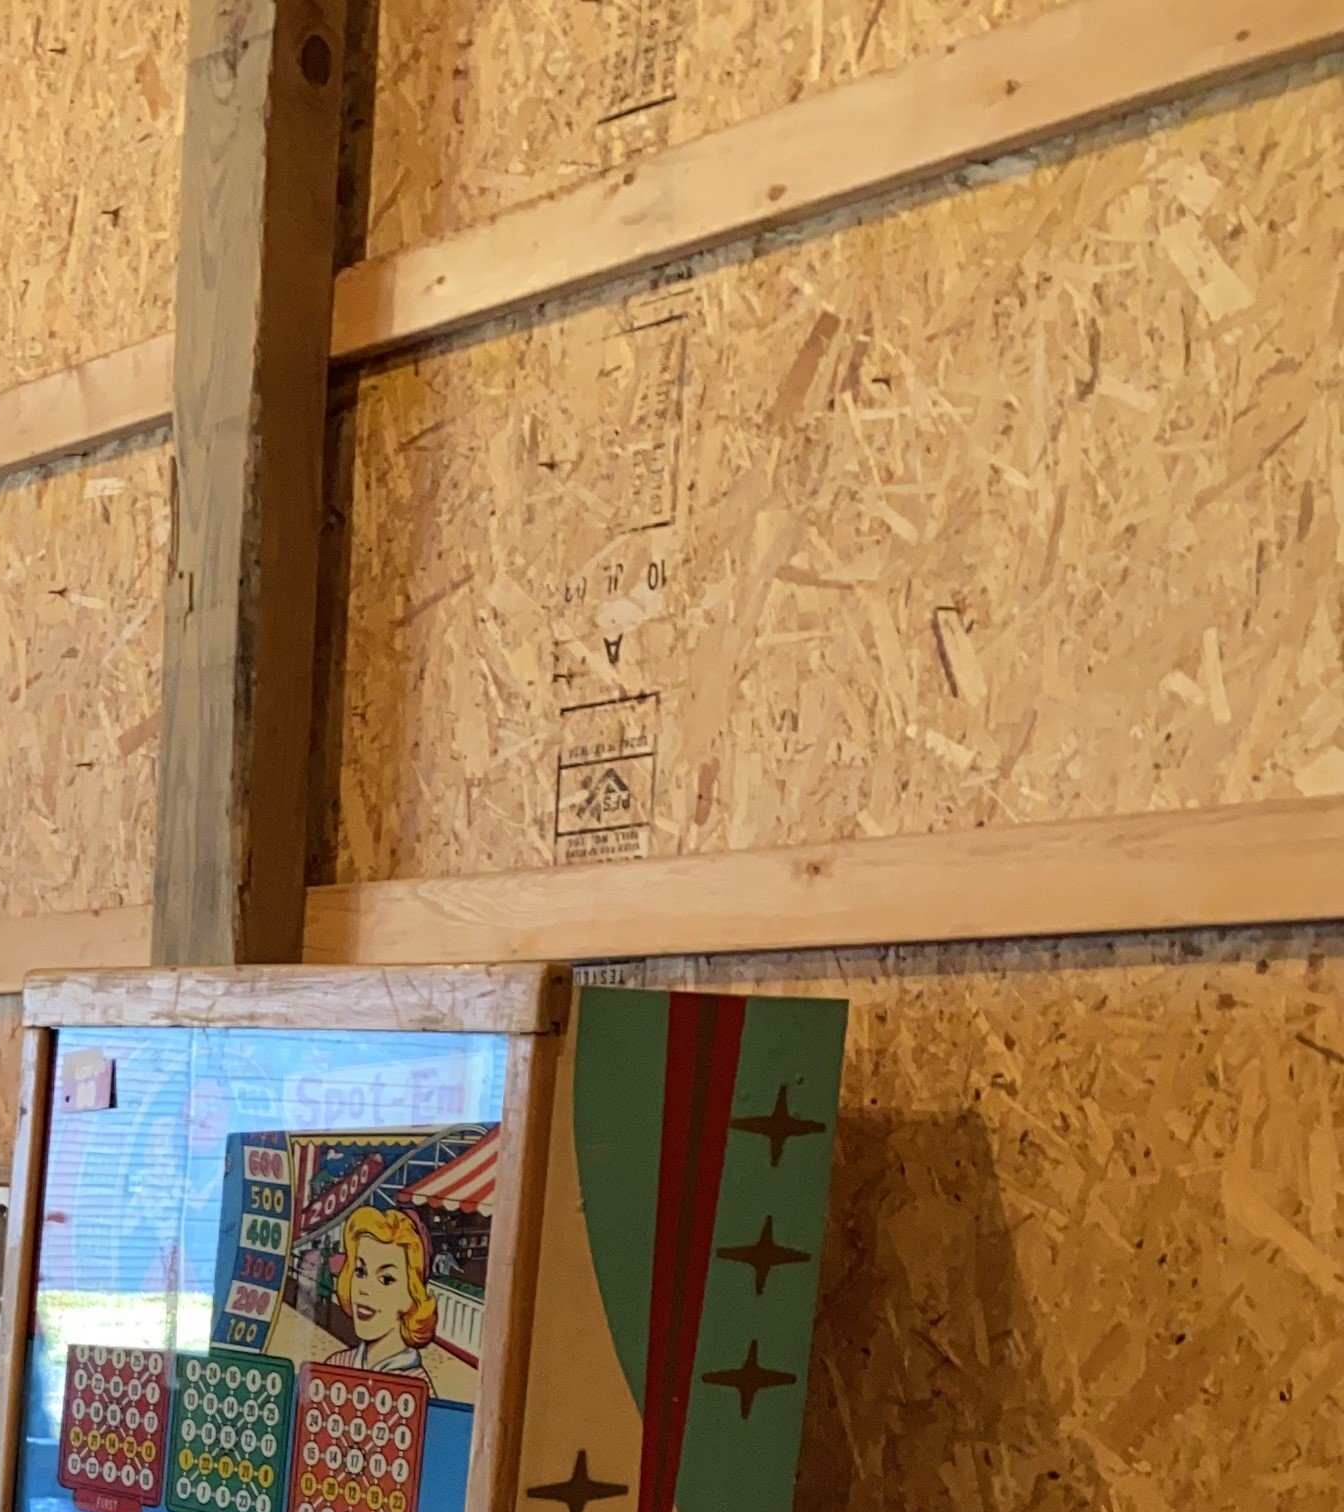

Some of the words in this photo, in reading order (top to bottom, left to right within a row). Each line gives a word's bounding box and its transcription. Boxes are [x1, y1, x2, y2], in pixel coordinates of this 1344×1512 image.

[248, 1150, 283, 1179] 600
[250, 1185, 284, 1213] 500
[246, 1218, 282, 1249] 400
[243, 1253, 276, 1281] 300
[231, 1286, 270, 1315] 200
[228, 1318, 258, 1343] 100
